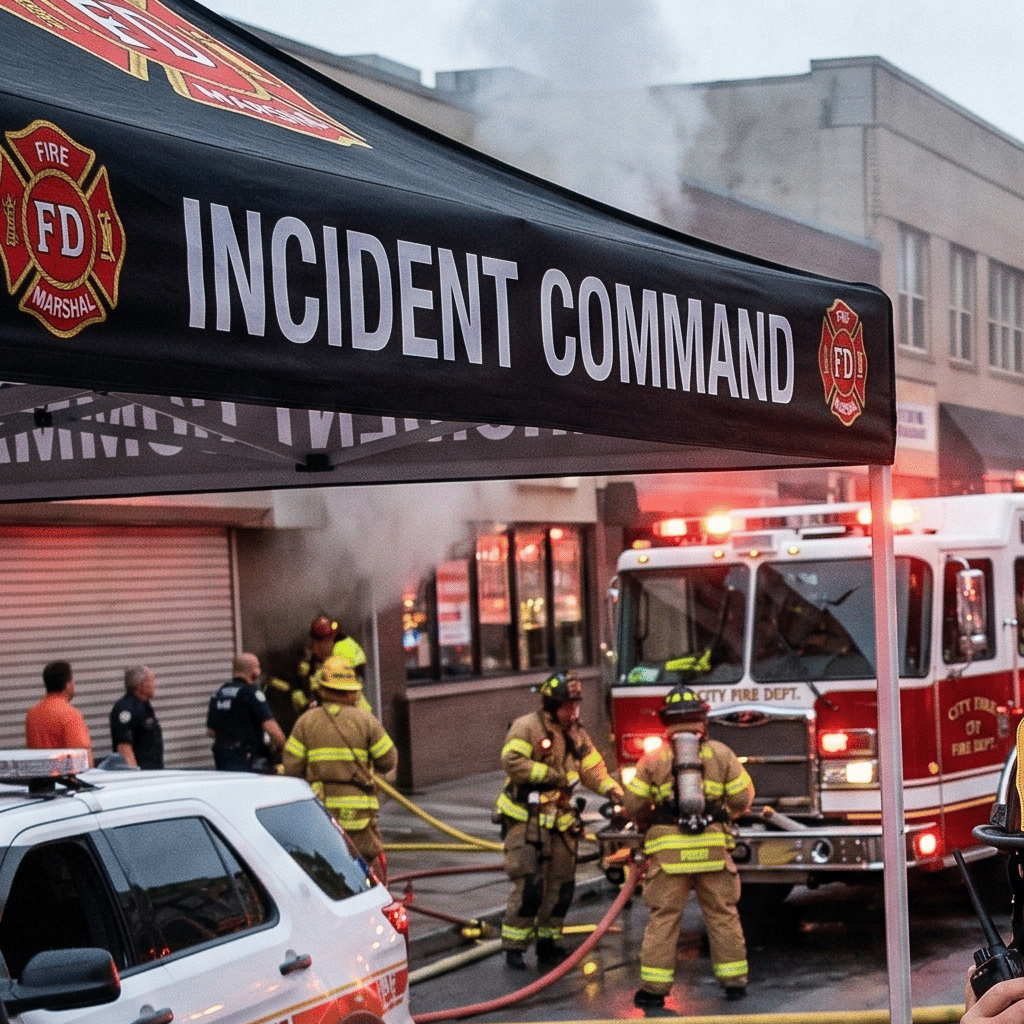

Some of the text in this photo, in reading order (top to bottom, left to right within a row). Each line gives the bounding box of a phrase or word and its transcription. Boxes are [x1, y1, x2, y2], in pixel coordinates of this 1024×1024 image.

[35, 141, 69, 167] FIRE
[34, 200, 85, 258] FD
[32, 285, 96, 319] MARSHAL
[182, 197, 795, 404] INCIDENT COMMAND
[834, 346, 853, 379] FD
